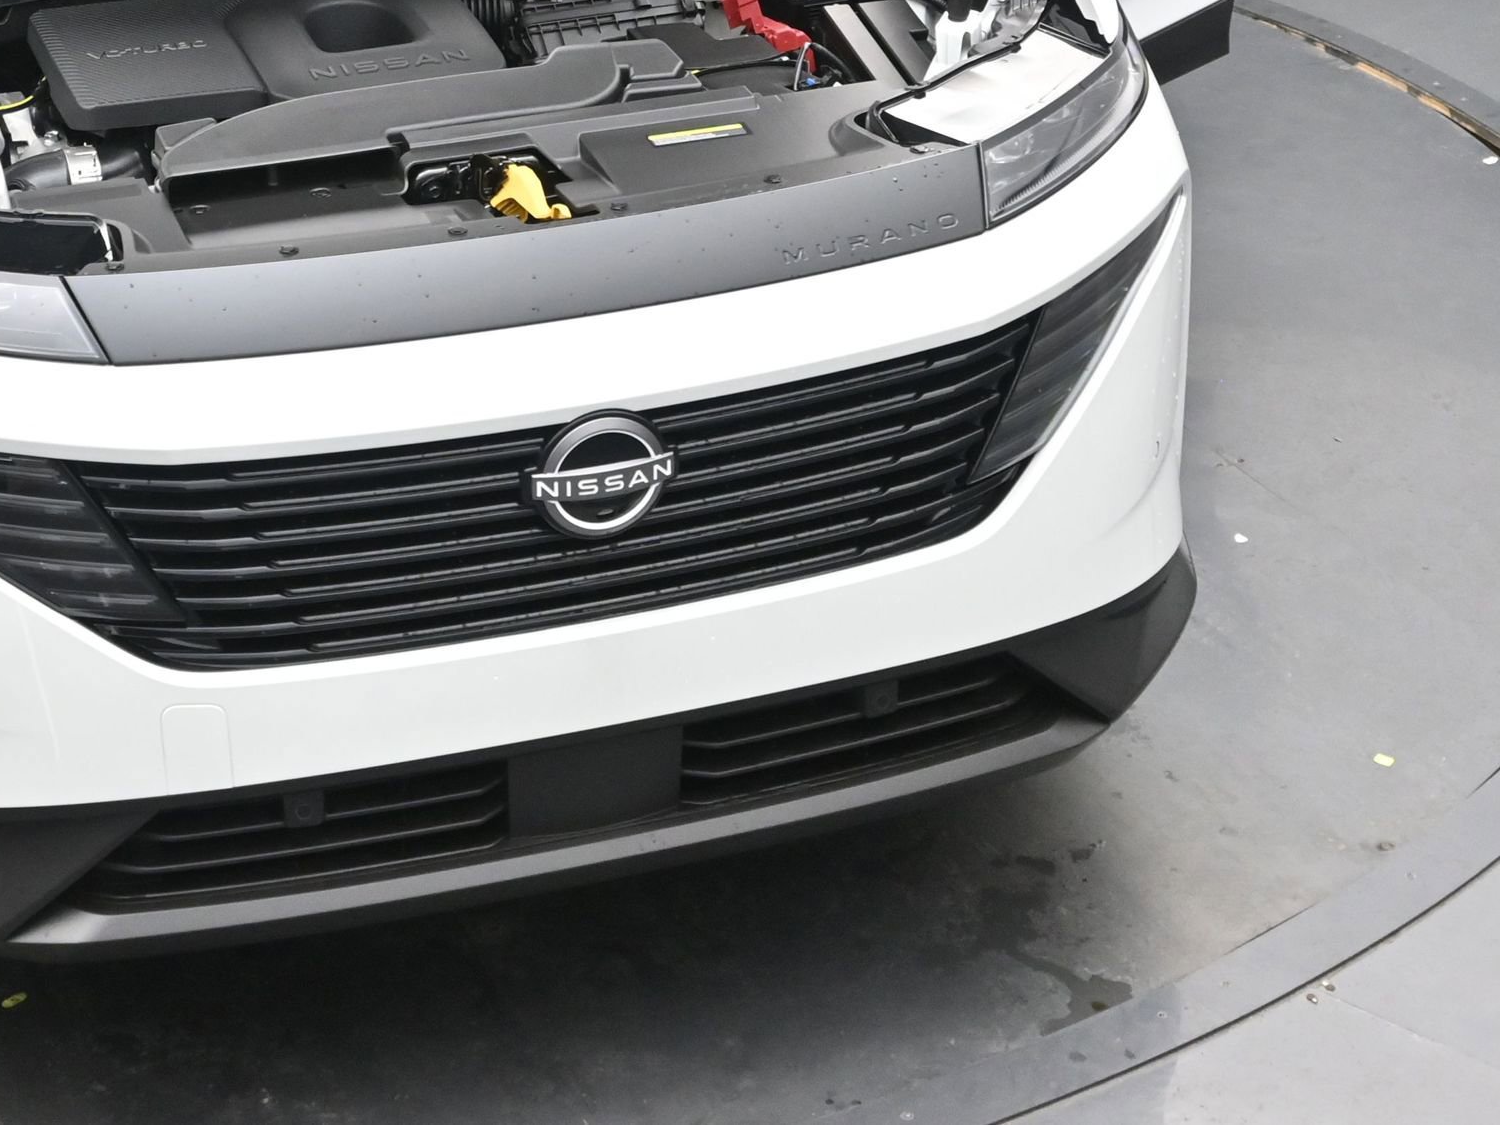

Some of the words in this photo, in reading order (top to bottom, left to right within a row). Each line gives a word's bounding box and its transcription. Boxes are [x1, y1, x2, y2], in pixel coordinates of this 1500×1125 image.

[308, 48, 472, 81] NISSAN
[781, 212, 960, 265] MURANO
[535, 458, 673, 498] NISSAN
